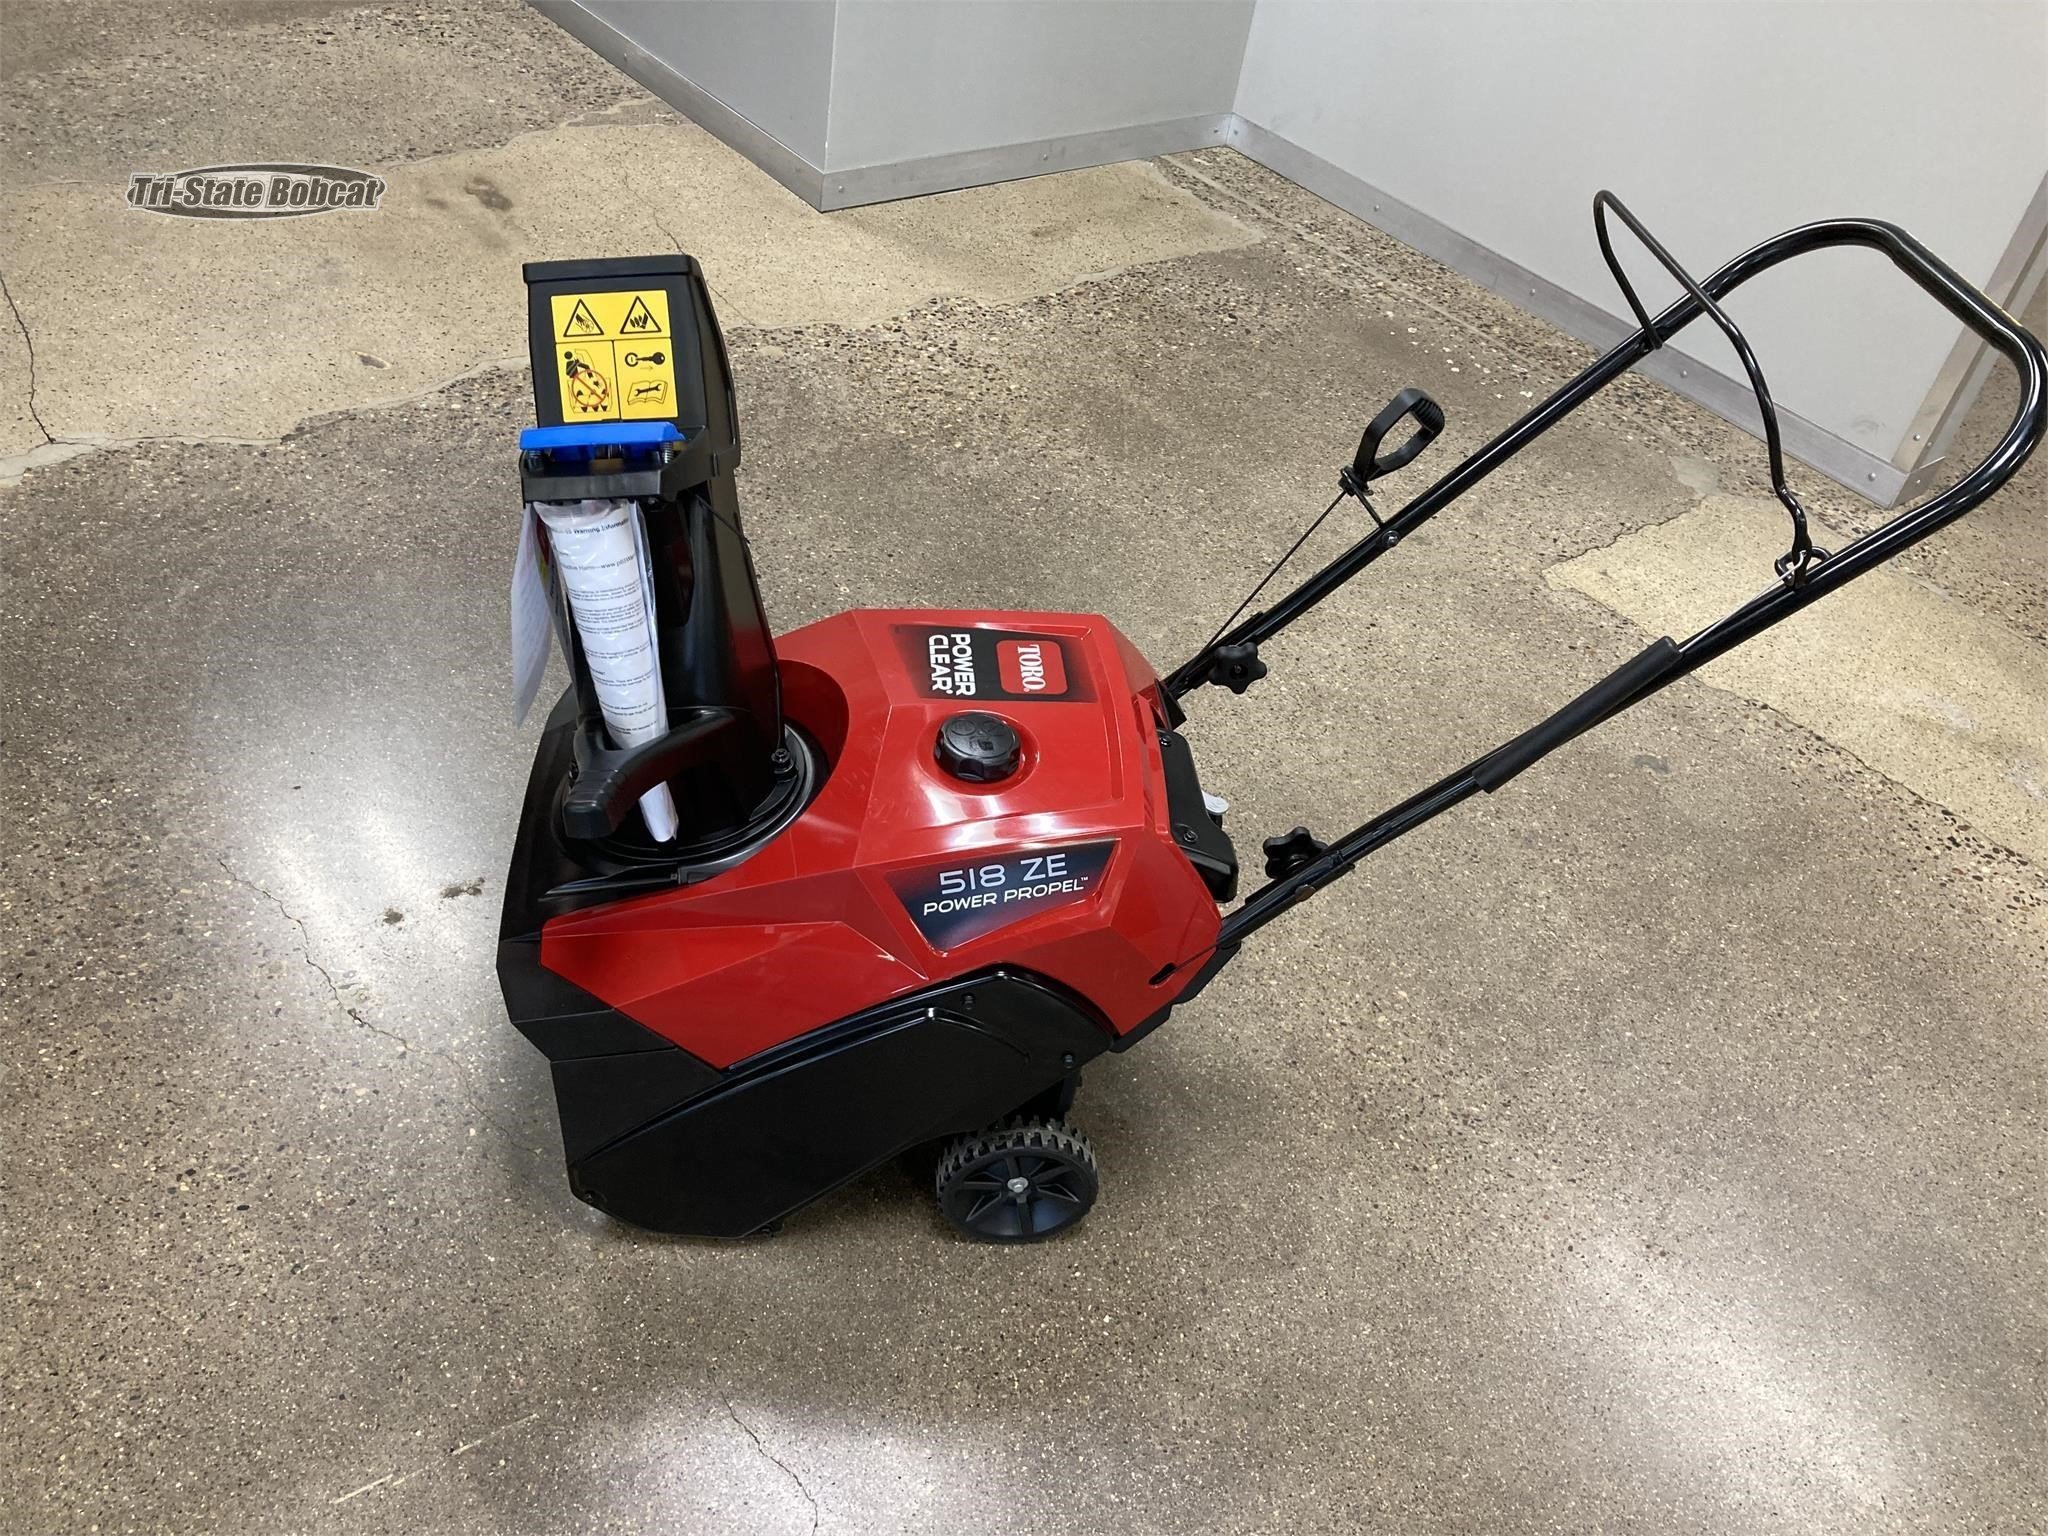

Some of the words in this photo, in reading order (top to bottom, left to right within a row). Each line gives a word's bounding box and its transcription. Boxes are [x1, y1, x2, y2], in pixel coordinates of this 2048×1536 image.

[928, 634, 953, 693] CLEAR
[950, 633, 977, 696] POWER
[1017, 643, 1047, 692] TORO
[939, 864, 1006, 895] 518
[1020, 853, 1068, 882] ZE
[923, 892, 997, 916] POWER
